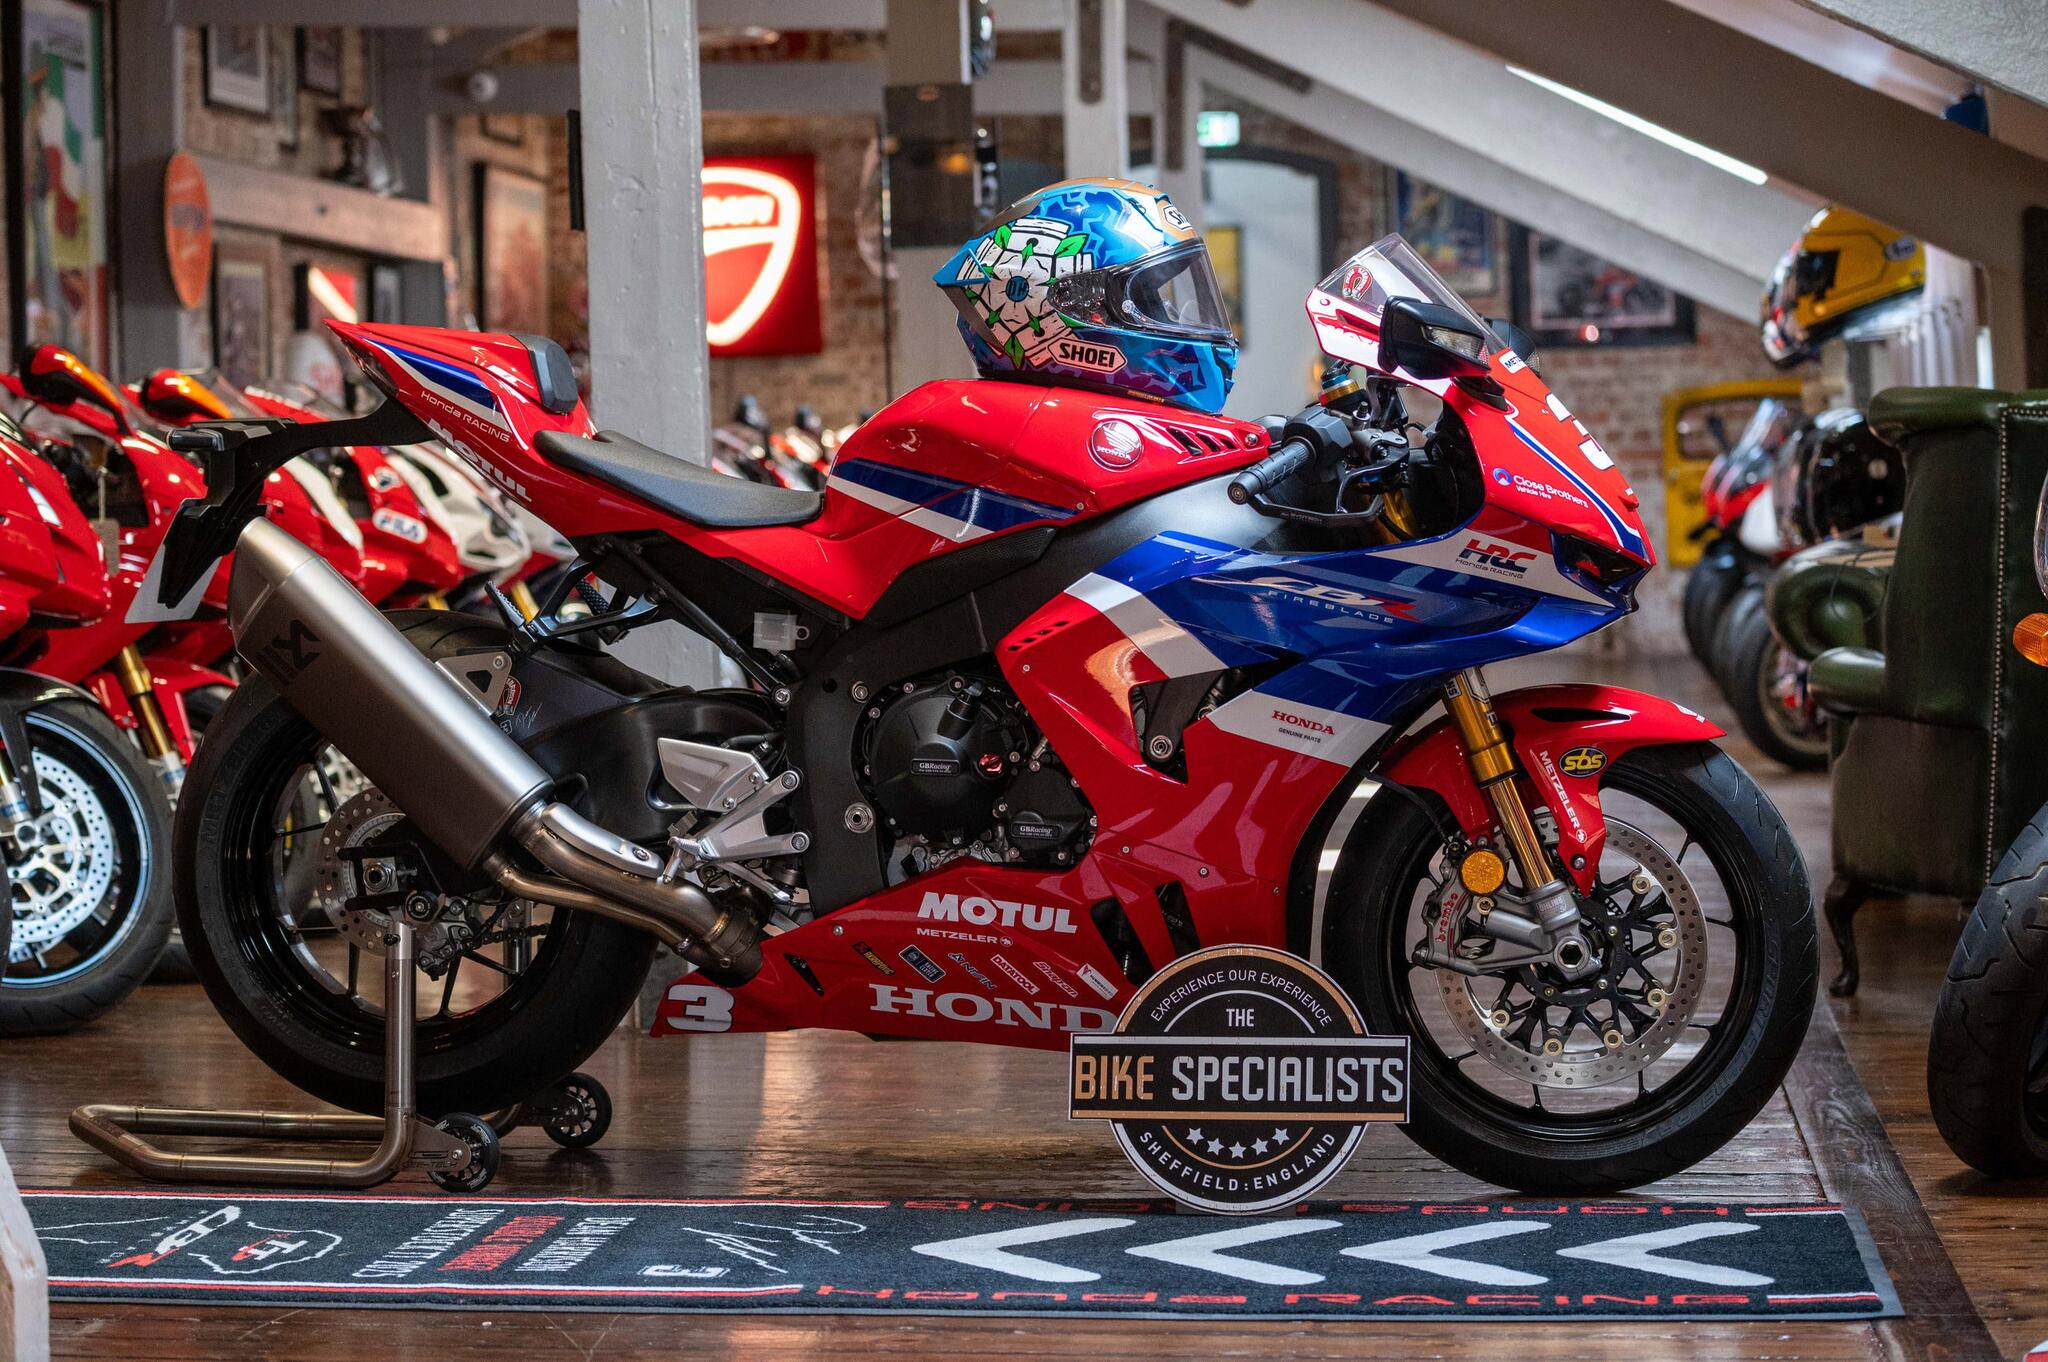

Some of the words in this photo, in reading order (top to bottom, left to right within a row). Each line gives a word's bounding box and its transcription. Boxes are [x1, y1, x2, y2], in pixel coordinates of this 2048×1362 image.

[1059, 342, 1116, 369] SHOEI
[421, 390, 462, 417] Honda
[463, 412, 511, 443] RACING
[427, 418, 532, 502] MOTUL
[1096, 445, 1132, 462] HONDA
[1513, 475, 1545, 493] Close
[1545, 484, 1589, 509] Brothers
[1516, 484, 1538, 497] Vehicle
[1539, 491, 1552, 500] Hire
[1456, 558, 1489, 572] Honda
[1490, 568, 1524, 580] RACING
[1459, 539, 1538, 573] HRC
[1268, 590, 1394, 625] FIREBLADE
[1272, 710, 1336, 736] HONDA
[1278, 727, 1303, 739] GENUINE
[1303, 734, 1322, 743] PARTS
[919, 762, 951, 772] GBRacing
[1539, 750, 1581, 829] METZELER
[1020, 825, 1053, 835] GBRacing
[917, 891, 1078, 934] MOTUL
[1435, 893, 1458, 942] brembo
[916, 927, 998, 944] METZELER
[993, 956, 1037, 995] DATATOOL
[667, 984, 735, 1033] 3
[868, 984, 1119, 1033] HOND
[1151, 970, 1225, 1022] EXPERIENCE
[1228, 970, 1256, 982] OUR
[1260, 972, 1332, 1027] EXPERIENCE
[1226, 1009, 1255, 1027] THE
[1075, 1055, 1154, 1101] BIKE
[1171, 1056, 1404, 1103] SPECIALISTS
[815, 1284, 1247, 1303] Honda
[1283, 1293, 1749, 1306] RACING
